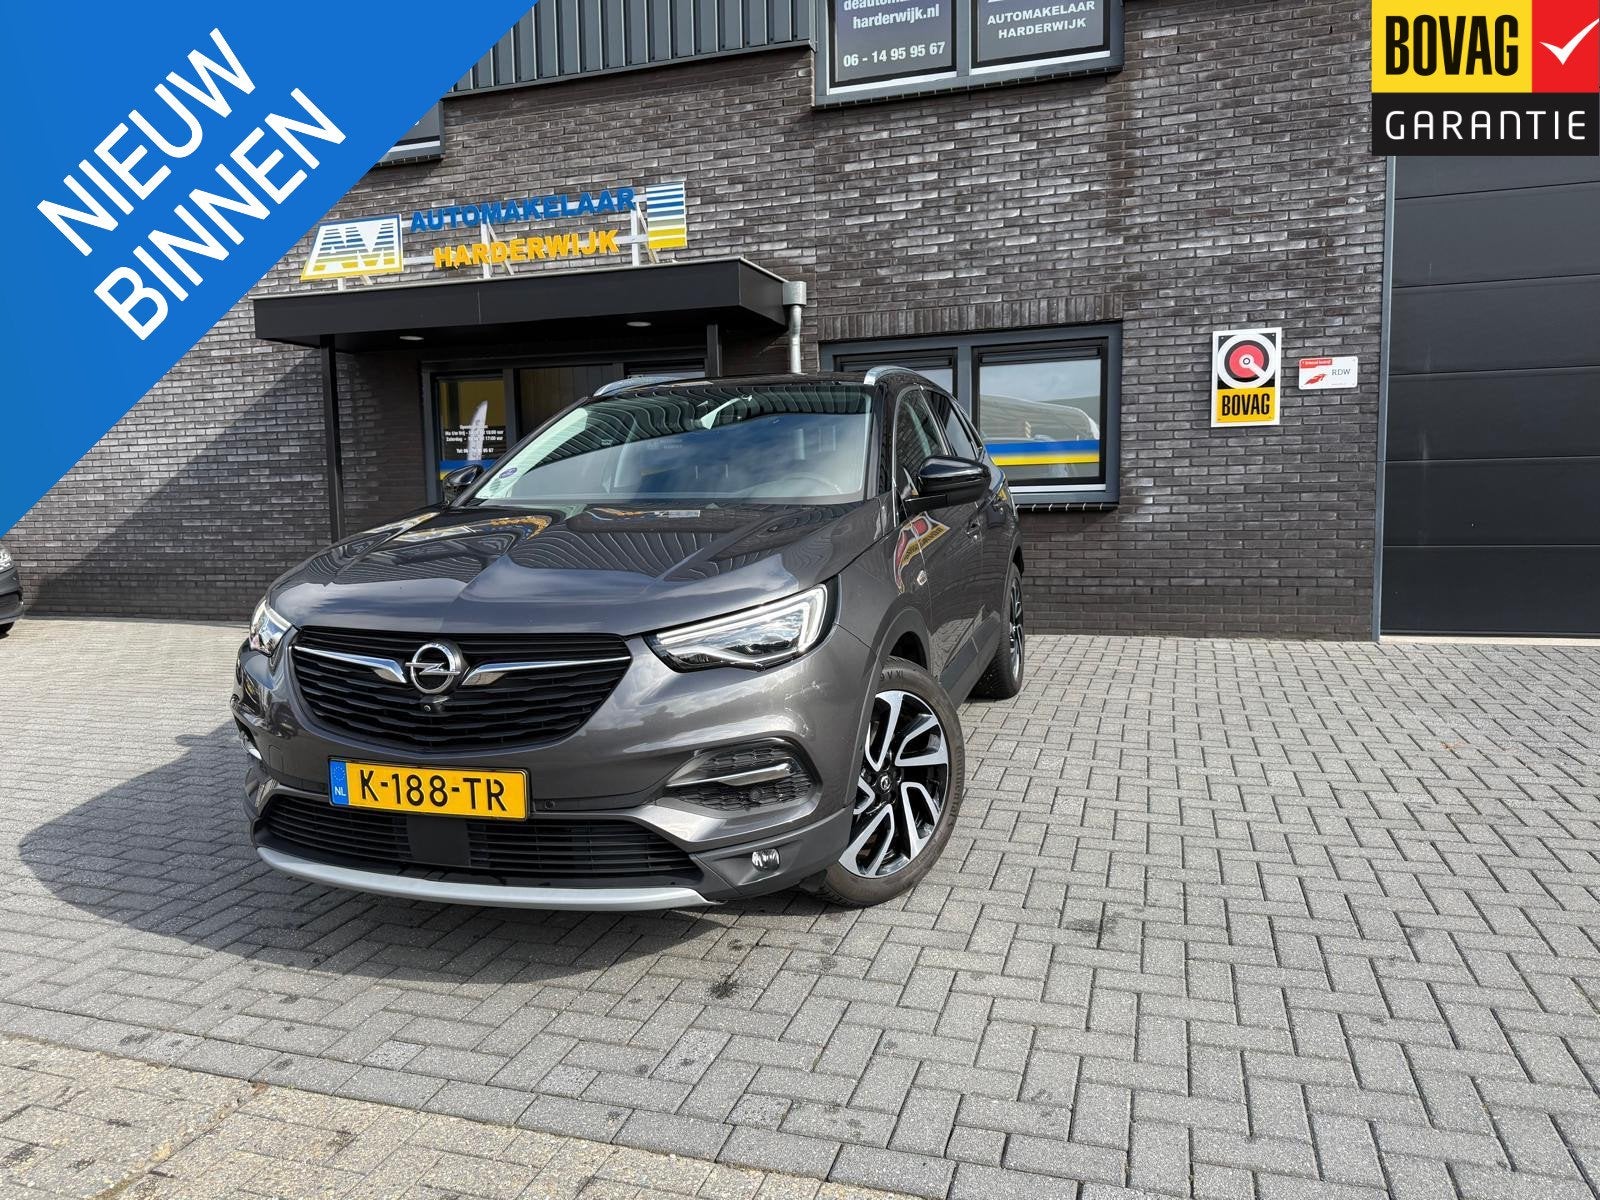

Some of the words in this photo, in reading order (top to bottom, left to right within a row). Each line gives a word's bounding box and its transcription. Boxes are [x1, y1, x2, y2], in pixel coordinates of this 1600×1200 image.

[853, 3, 940, 29] harderwijk.nl
[987, 1, 1095, 25] AUTOMAKELAAR
[998, 17, 1087, 39] HARDERWIJK
[843, 53, 859, 67] 06
[872, 50, 888, 63] 14
[890, 47, 906, 61] 95
[910, 44, 926, 58] 95
[929, 41, 945, 55] 67
[410, 187, 635, 233] AUTOMAKELAAR
[433, 229, 621, 270] HARDERWIJK
[1331, 368, 1351, 376] RDW
[1221, 393, 1271, 416] BOVAG
[334, 786, 346, 797] NL
[359, 769, 507, 811] K-188-TR
